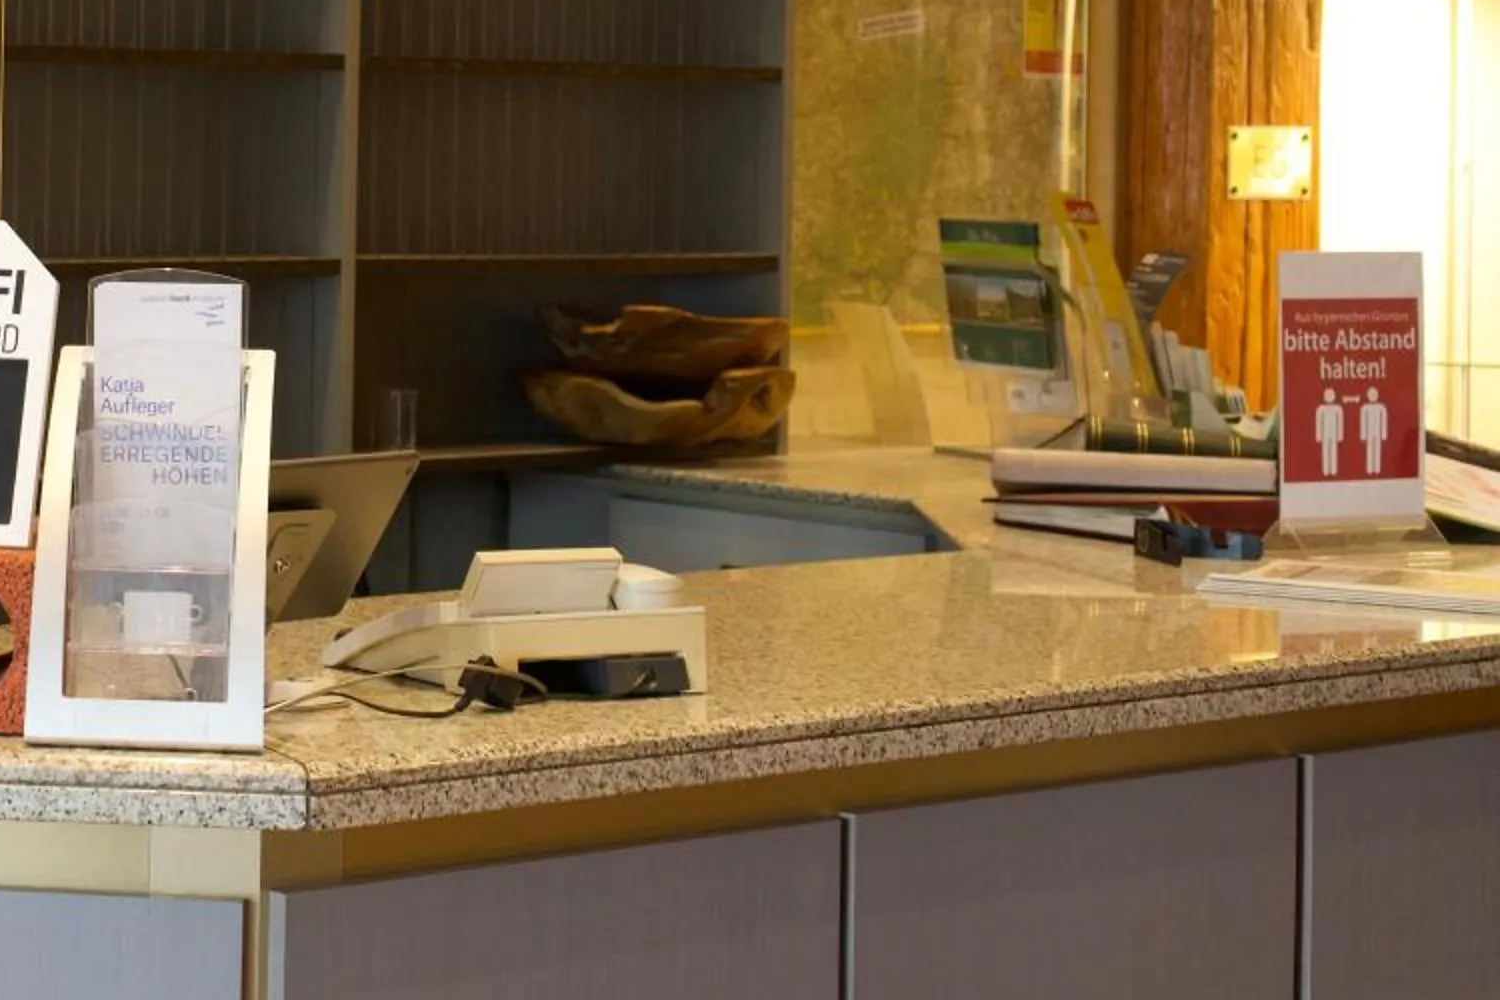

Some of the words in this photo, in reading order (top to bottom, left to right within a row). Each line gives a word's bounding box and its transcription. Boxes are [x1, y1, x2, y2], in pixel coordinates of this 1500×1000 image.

[1284, 327, 1331, 351] bitte
[1335, 327, 1416, 351] Abstand
[1319, 355, 1387, 379] halten!
[101, 376, 145, 397] Katja
[100, 397, 176, 417] Aufleger
[101, 422, 229, 442] SCHWINDEL
[101, 445, 228, 463] ERREGENDE
